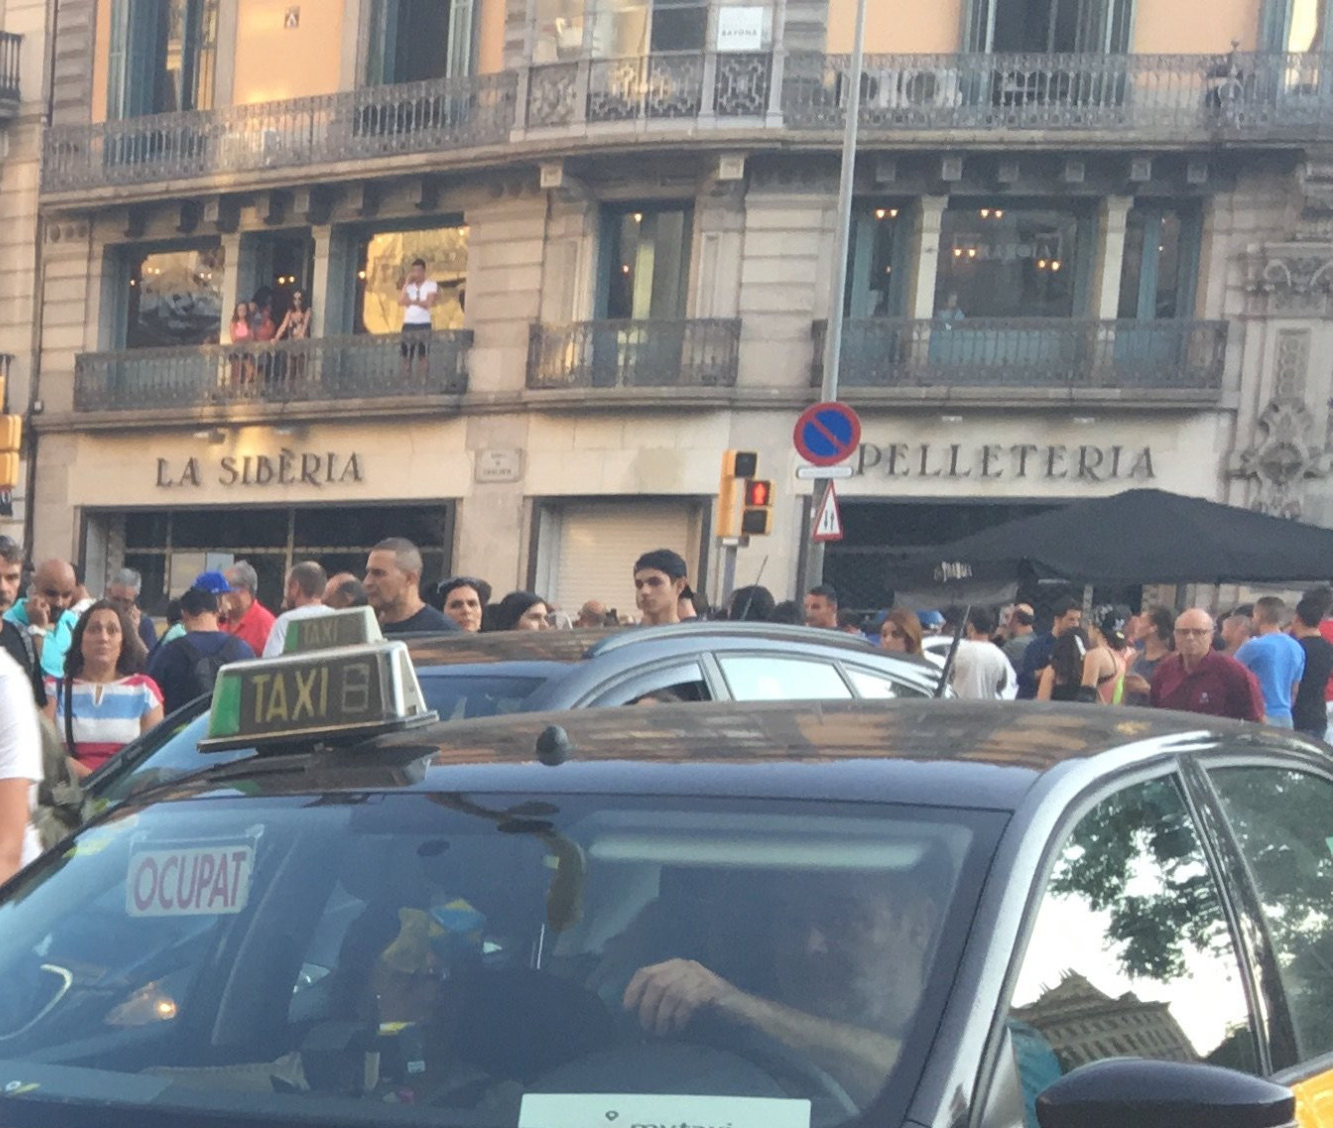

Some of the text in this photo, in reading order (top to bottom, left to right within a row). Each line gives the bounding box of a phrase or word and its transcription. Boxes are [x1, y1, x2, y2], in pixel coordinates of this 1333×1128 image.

[155, 447, 363, 488] LA SIBÈRIA
[854, 443, 1156, 482] PELLETERIA
[301, 618, 339, 644] TAXI
[251, 666, 329, 724] TAXI
[133, 850, 247, 912] OCUPAT
